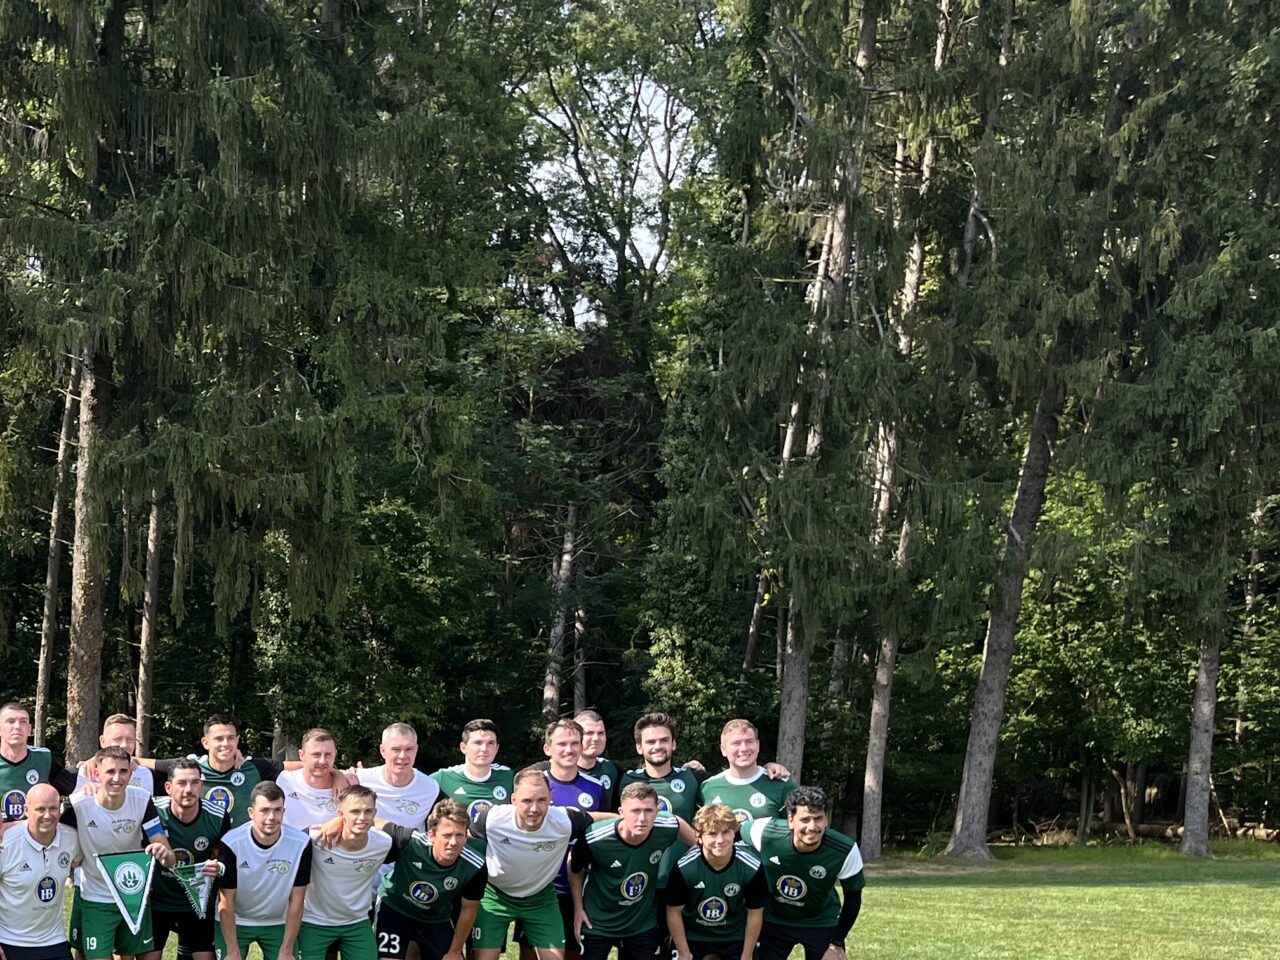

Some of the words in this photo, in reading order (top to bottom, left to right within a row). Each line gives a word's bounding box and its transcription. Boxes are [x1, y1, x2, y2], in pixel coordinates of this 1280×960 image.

[8, 805, 23, 815] HB
[40, 888, 54, 900] HB
[784, 885, 798, 897] HB
[706, 909, 721, 918] HB
[86, 936, 97, 950] 19
[378, 932, 400, 954] 23
